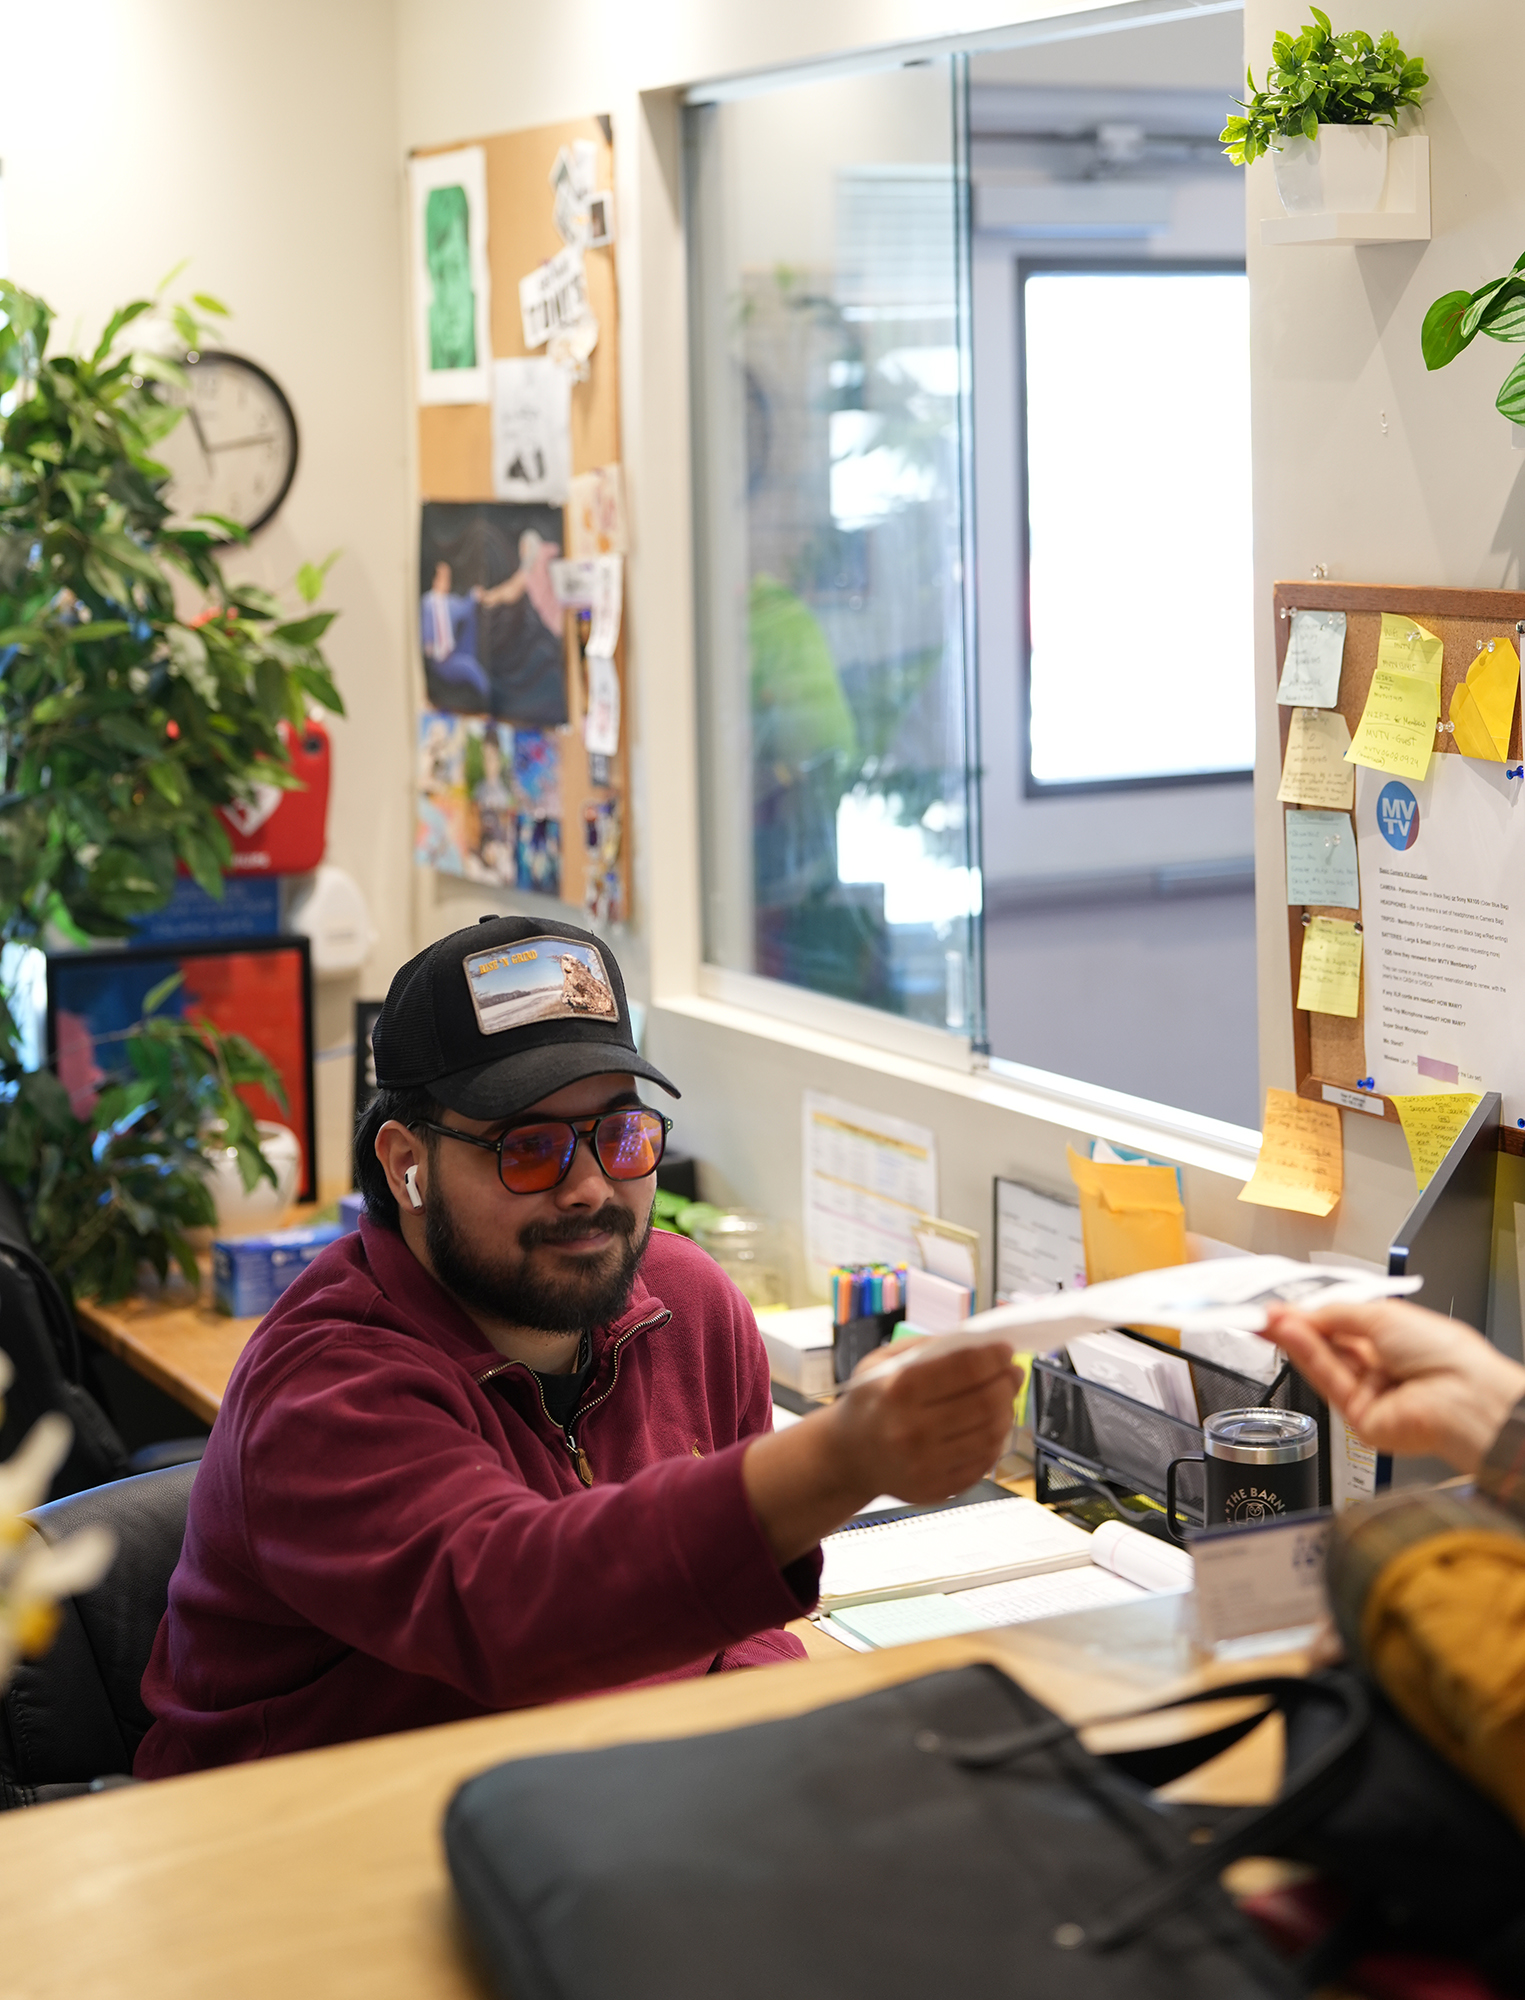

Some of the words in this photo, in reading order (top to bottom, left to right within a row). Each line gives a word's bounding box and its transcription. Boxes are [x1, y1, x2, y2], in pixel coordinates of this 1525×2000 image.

[1382, 798, 1416, 820] MV
[1383, 818, 1410, 836] TV
[479, 960, 498, 974] RISE
[511, 951, 538, 964] GRIND
[1226, 1488, 1248, 1508] THE
[1250, 1487, 1286, 1511] BARN
